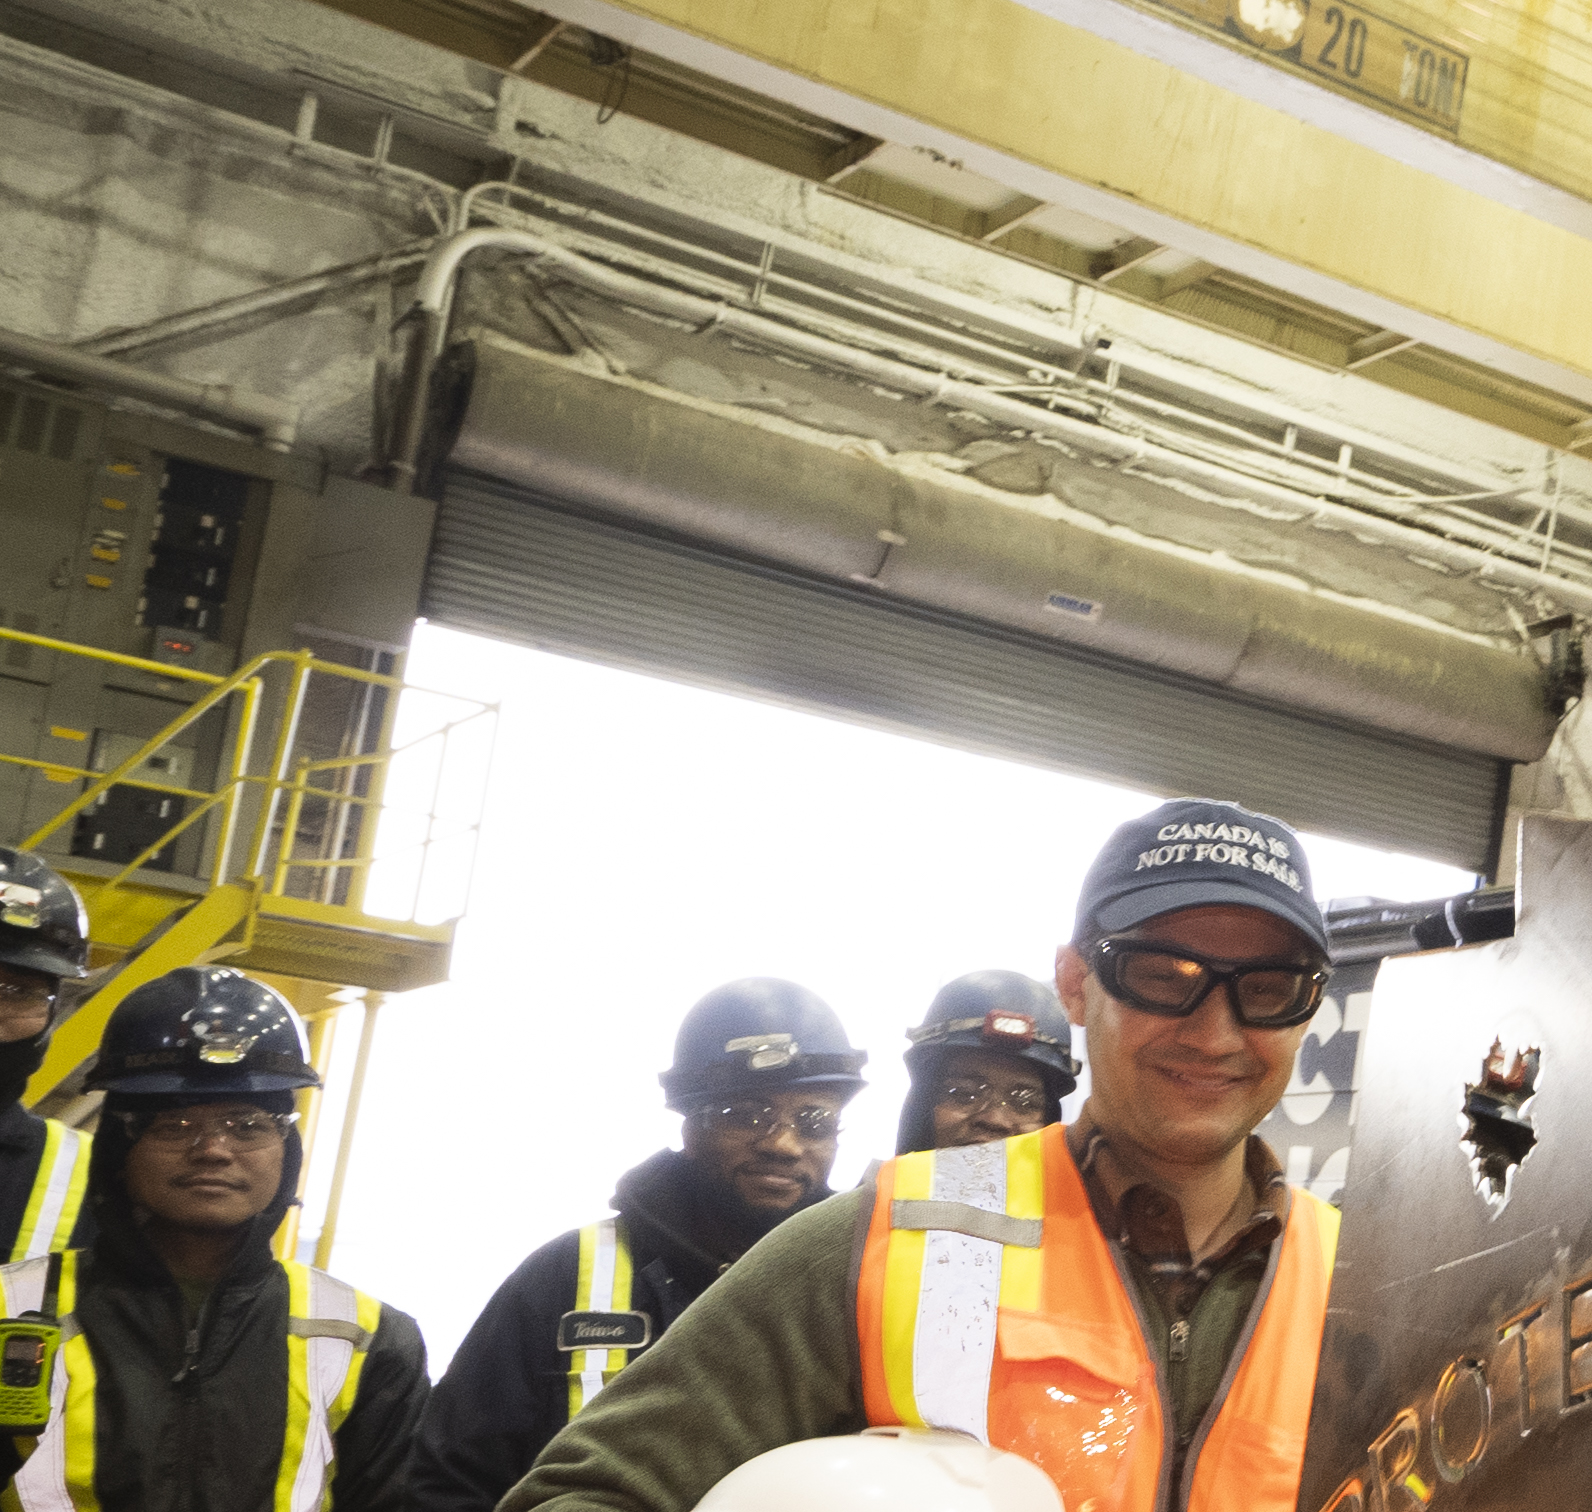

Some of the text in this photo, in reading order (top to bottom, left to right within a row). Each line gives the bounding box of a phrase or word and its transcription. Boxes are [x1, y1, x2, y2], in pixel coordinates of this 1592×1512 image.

[1318, 6, 1458, 117] 20 TON
[1157, 822, 1291, 859] CANADA IS
[1134, 843, 1303, 893] NOT FOR SALE
